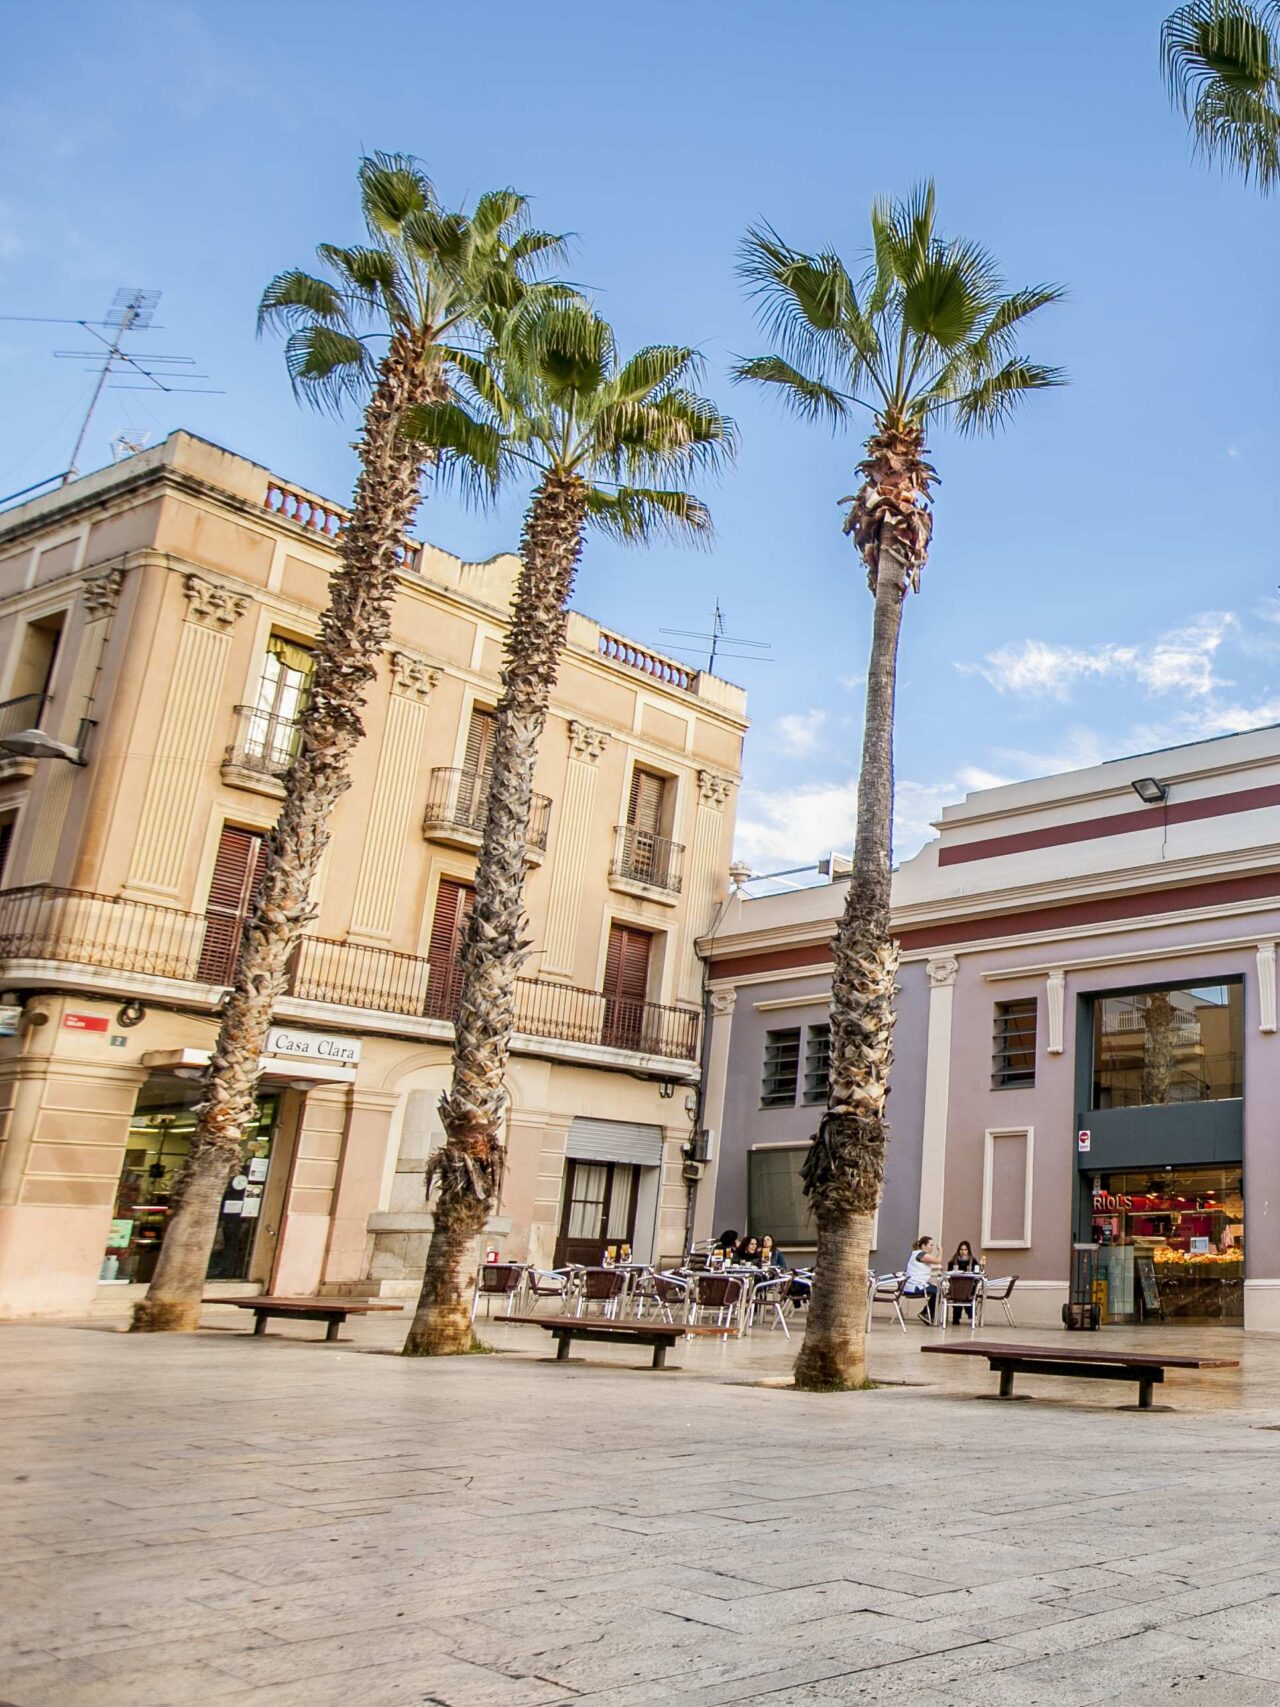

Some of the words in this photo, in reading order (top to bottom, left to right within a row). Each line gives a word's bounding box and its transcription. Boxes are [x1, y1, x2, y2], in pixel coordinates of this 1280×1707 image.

[275, 1034, 310, 1053] Casa
[317, 1040, 355, 1059] Clara
[1093, 1195, 1133, 1211] RIOLS
